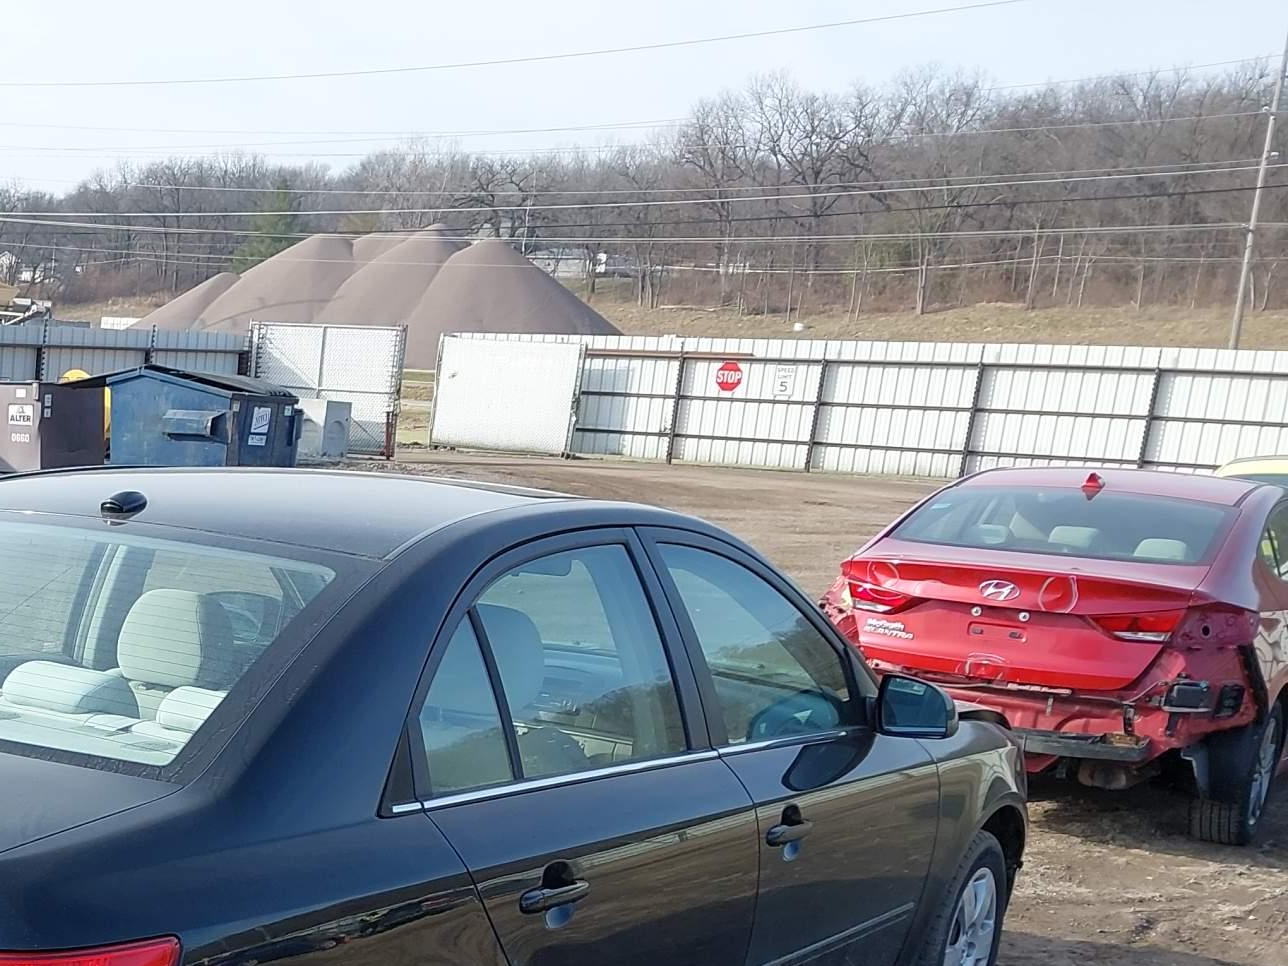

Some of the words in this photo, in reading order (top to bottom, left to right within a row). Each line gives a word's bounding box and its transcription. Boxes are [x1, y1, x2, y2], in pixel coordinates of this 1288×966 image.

[716, 370, 743, 384] STOP
[779, 381, 789, 392] 5
[10, 414, 32, 423] ALTER
